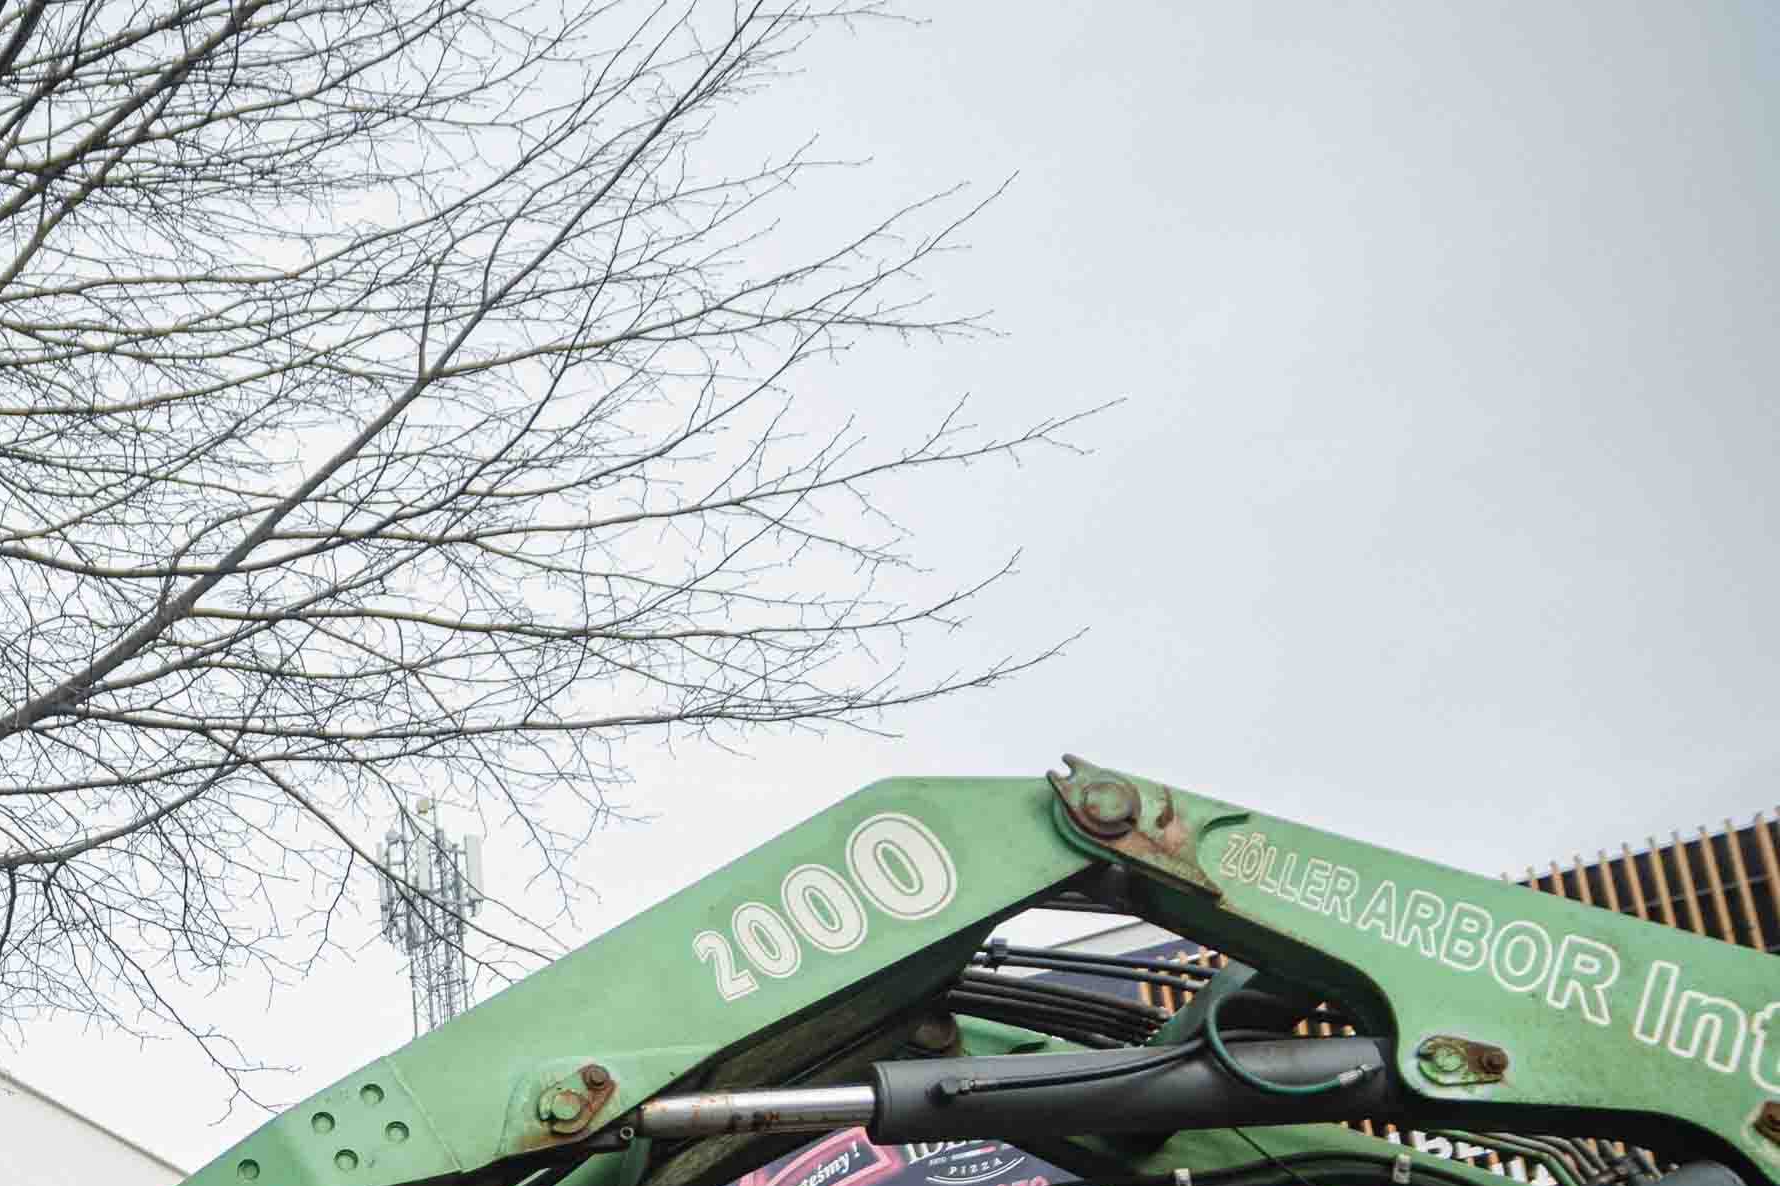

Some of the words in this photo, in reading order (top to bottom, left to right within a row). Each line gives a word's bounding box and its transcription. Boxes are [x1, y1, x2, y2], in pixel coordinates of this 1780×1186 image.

[692, 811, 957, 1001] 2000
[1219, 832, 1361, 923] ZÖLLER
[1357, 880, 1620, 1025] ARBOR
[948, 1157, 1003, 1176] PIZZA
